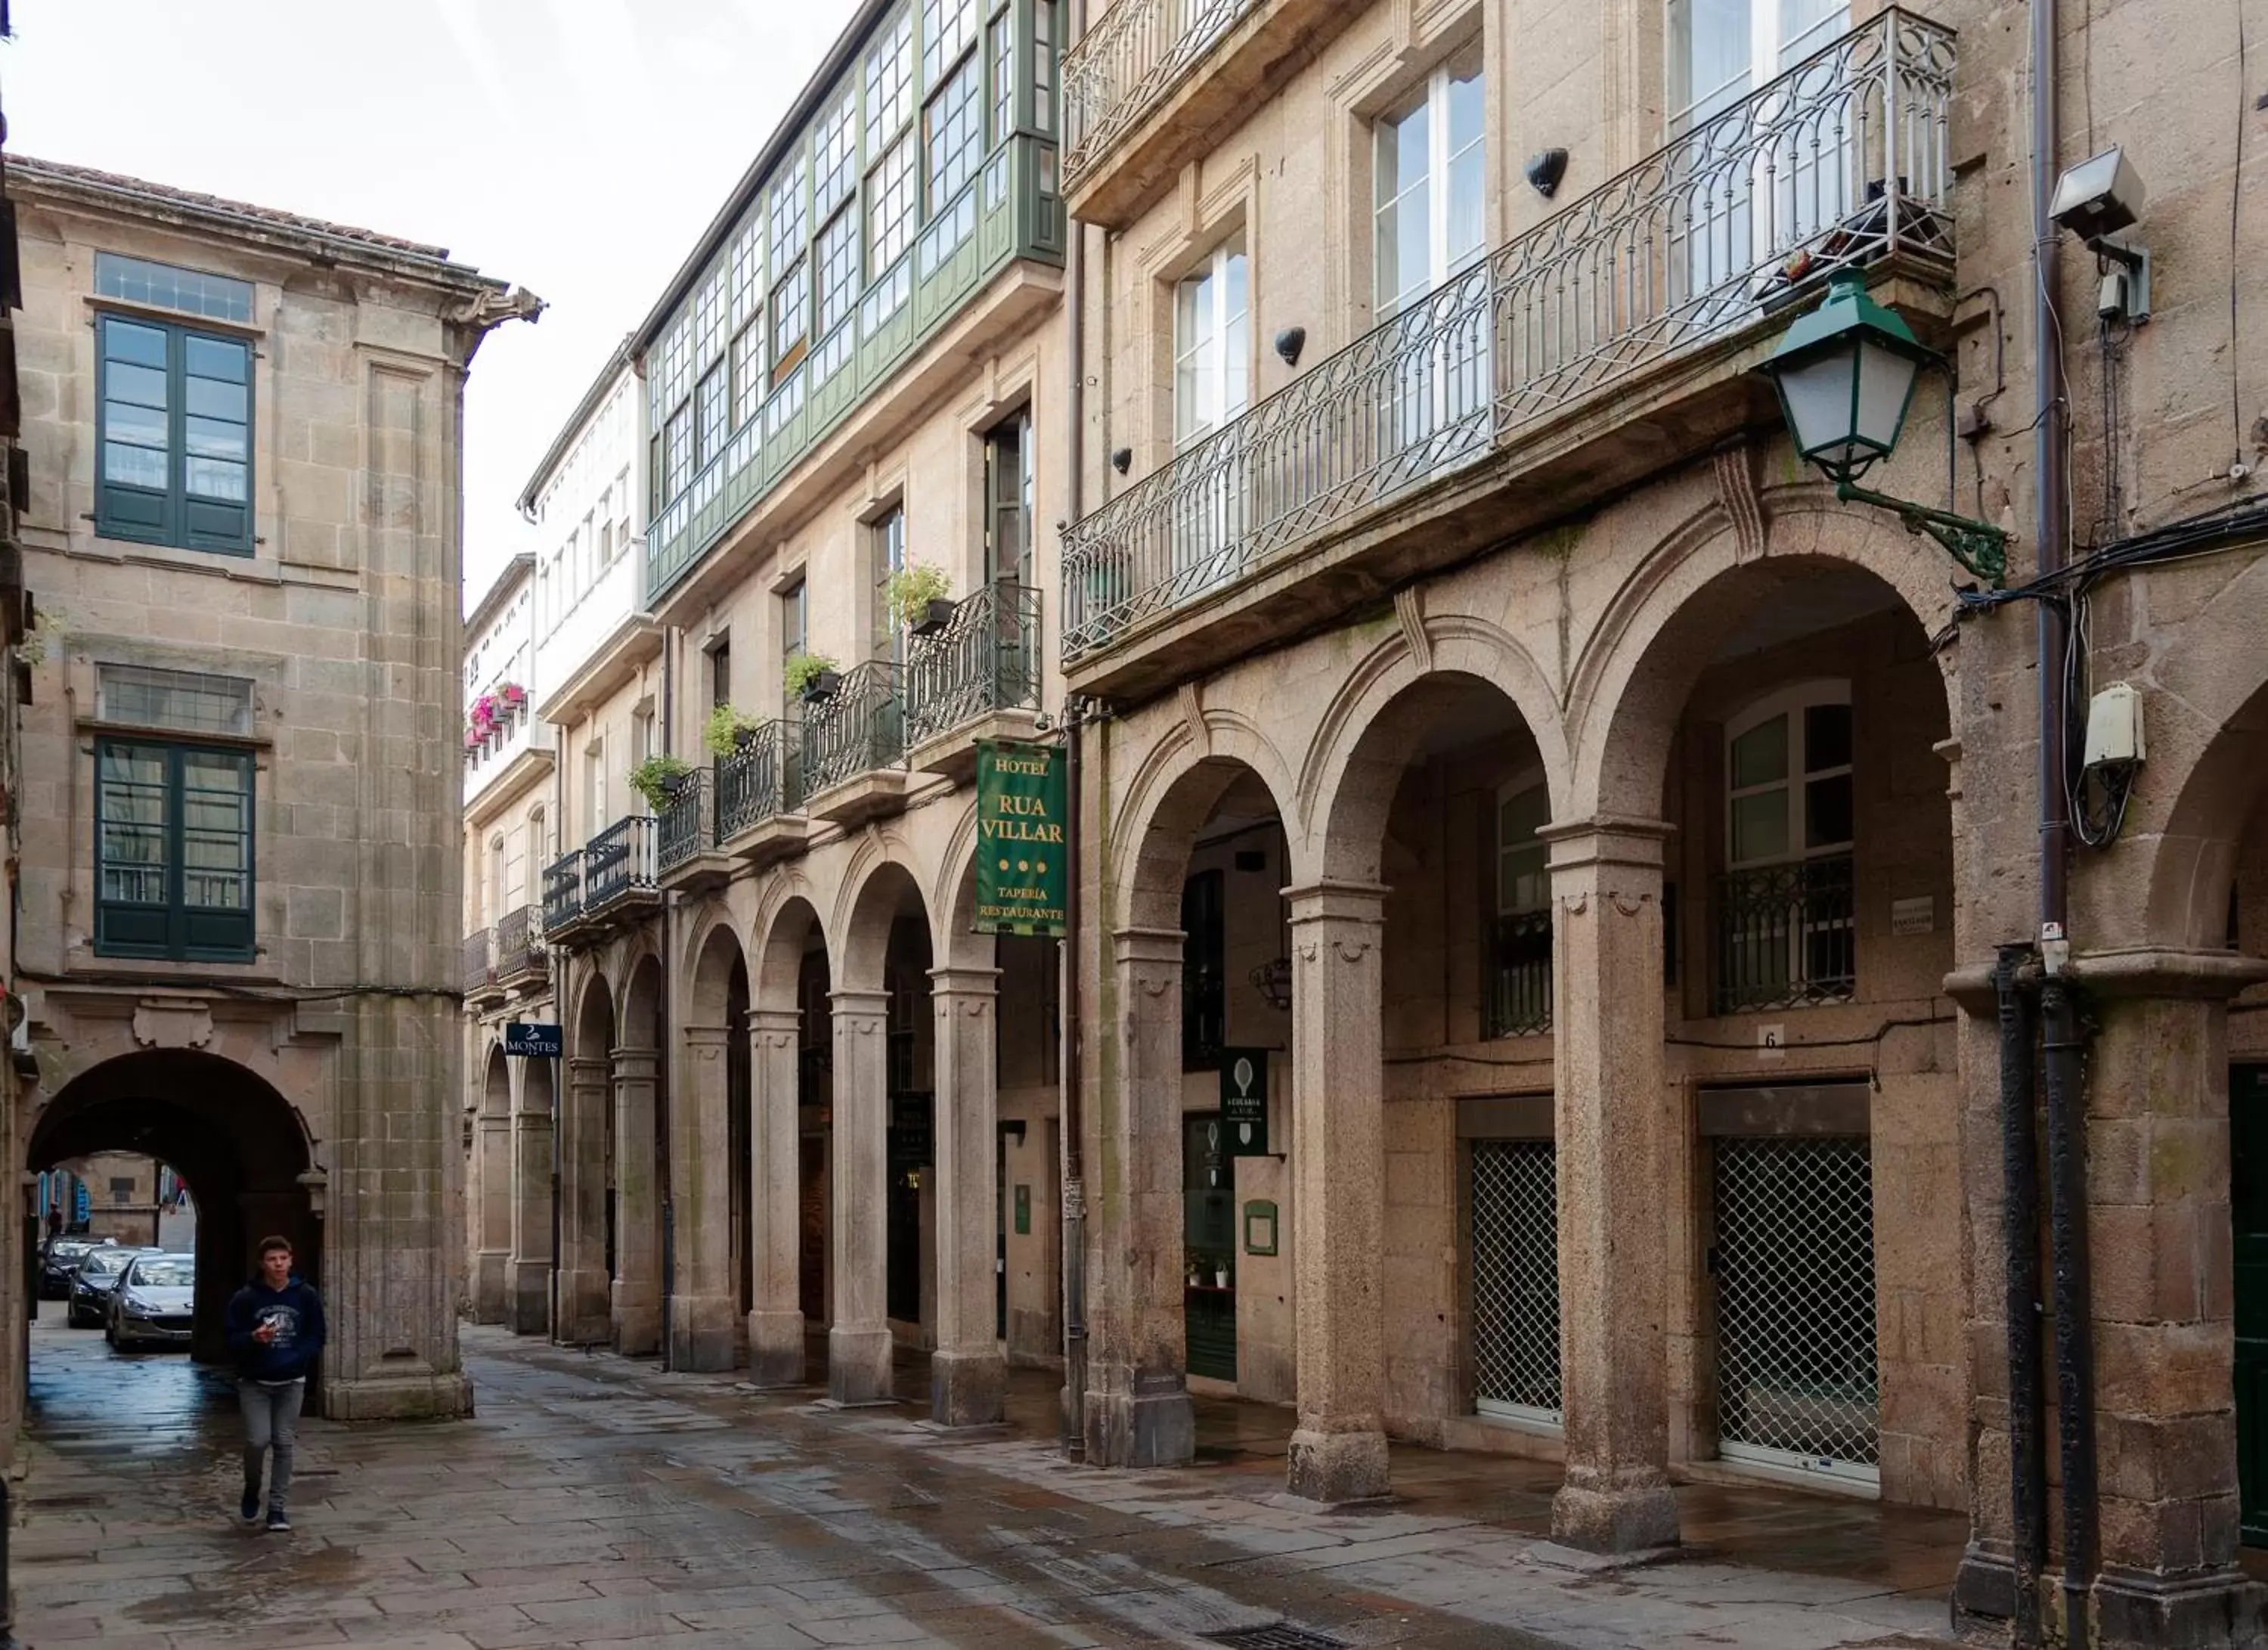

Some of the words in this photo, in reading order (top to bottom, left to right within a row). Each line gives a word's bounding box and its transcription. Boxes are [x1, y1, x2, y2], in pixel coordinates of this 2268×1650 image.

[996, 758, 1049, 776] HOTEL
[999, 796, 1046, 817] RUA
[981, 819, 1063, 842] VILLAR
[980, 906, 1064, 920] RESTAURANTE
[507, 1041, 558, 1052] MONTES
[1765, 1031, 1776, 1049] 6
